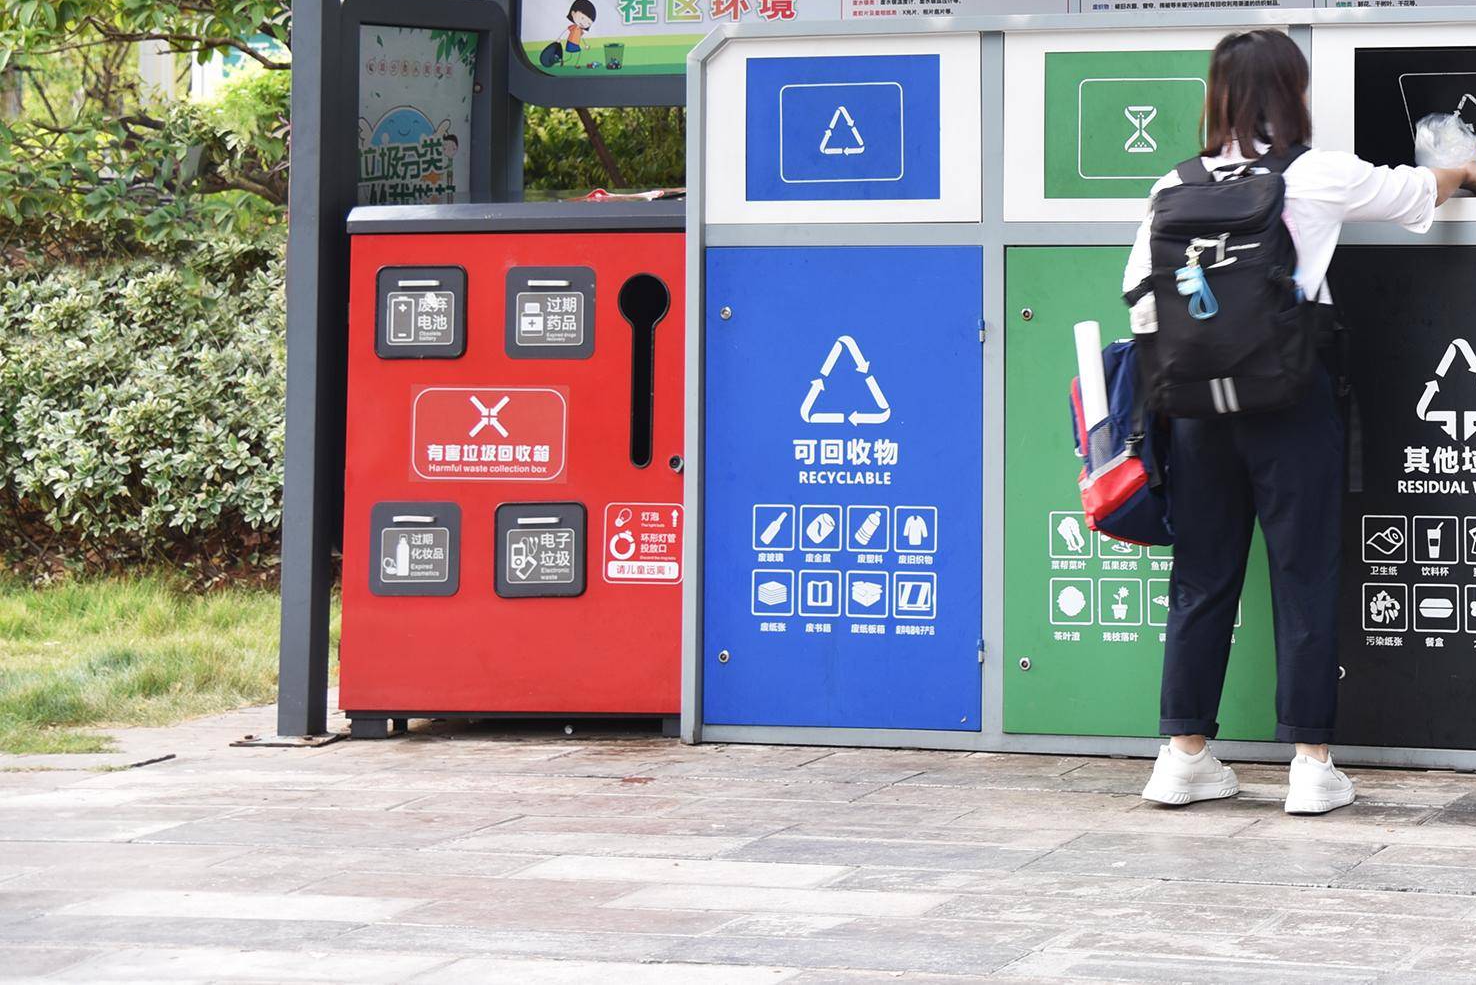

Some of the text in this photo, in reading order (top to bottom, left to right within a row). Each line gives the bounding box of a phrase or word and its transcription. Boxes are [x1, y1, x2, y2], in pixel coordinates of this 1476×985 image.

[359, 138, 443, 183] 垃圾分类
[547, 297, 577, 312] 过期
[418, 314, 447, 330] 电池
[547, 315, 577, 330] 药品
[426, 444, 550, 463] 有害垃圾回收箱
[793, 438, 899, 465] 可回收物
[428, 464, 547, 474] Harmful waste collection box
[799, 471, 891, 485] RECYCLABLE
[1397, 480, 1469, 494] RESIDUAL
[640, 512, 660, 521] 灯泡
[411, 533, 433, 545] 过期
[541, 532, 571, 548] 电子
[640, 533, 677, 543] 环形灯管
[411, 547, 444, 559] 化妆品
[640, 544, 667, 553] 投放口
[540, 550, 571, 566] 垃圾
[758, 552, 784, 562] 废玻璃
[805, 553, 831, 563] 废金属
[857, 553, 883, 564] 废塑料
[898, 554, 933, 565] 废旧织物
[1369, 566, 1398, 576] 卫生纸
[1421, 567, 1450, 576] 饮料杯
[760, 622, 786, 632] 废纸张
[1102, 632, 1138, 642] 残枝落叶
[1365, 636, 1403, 647] 污染纸张
[1425, 637, 1445, 647] 餐盒
